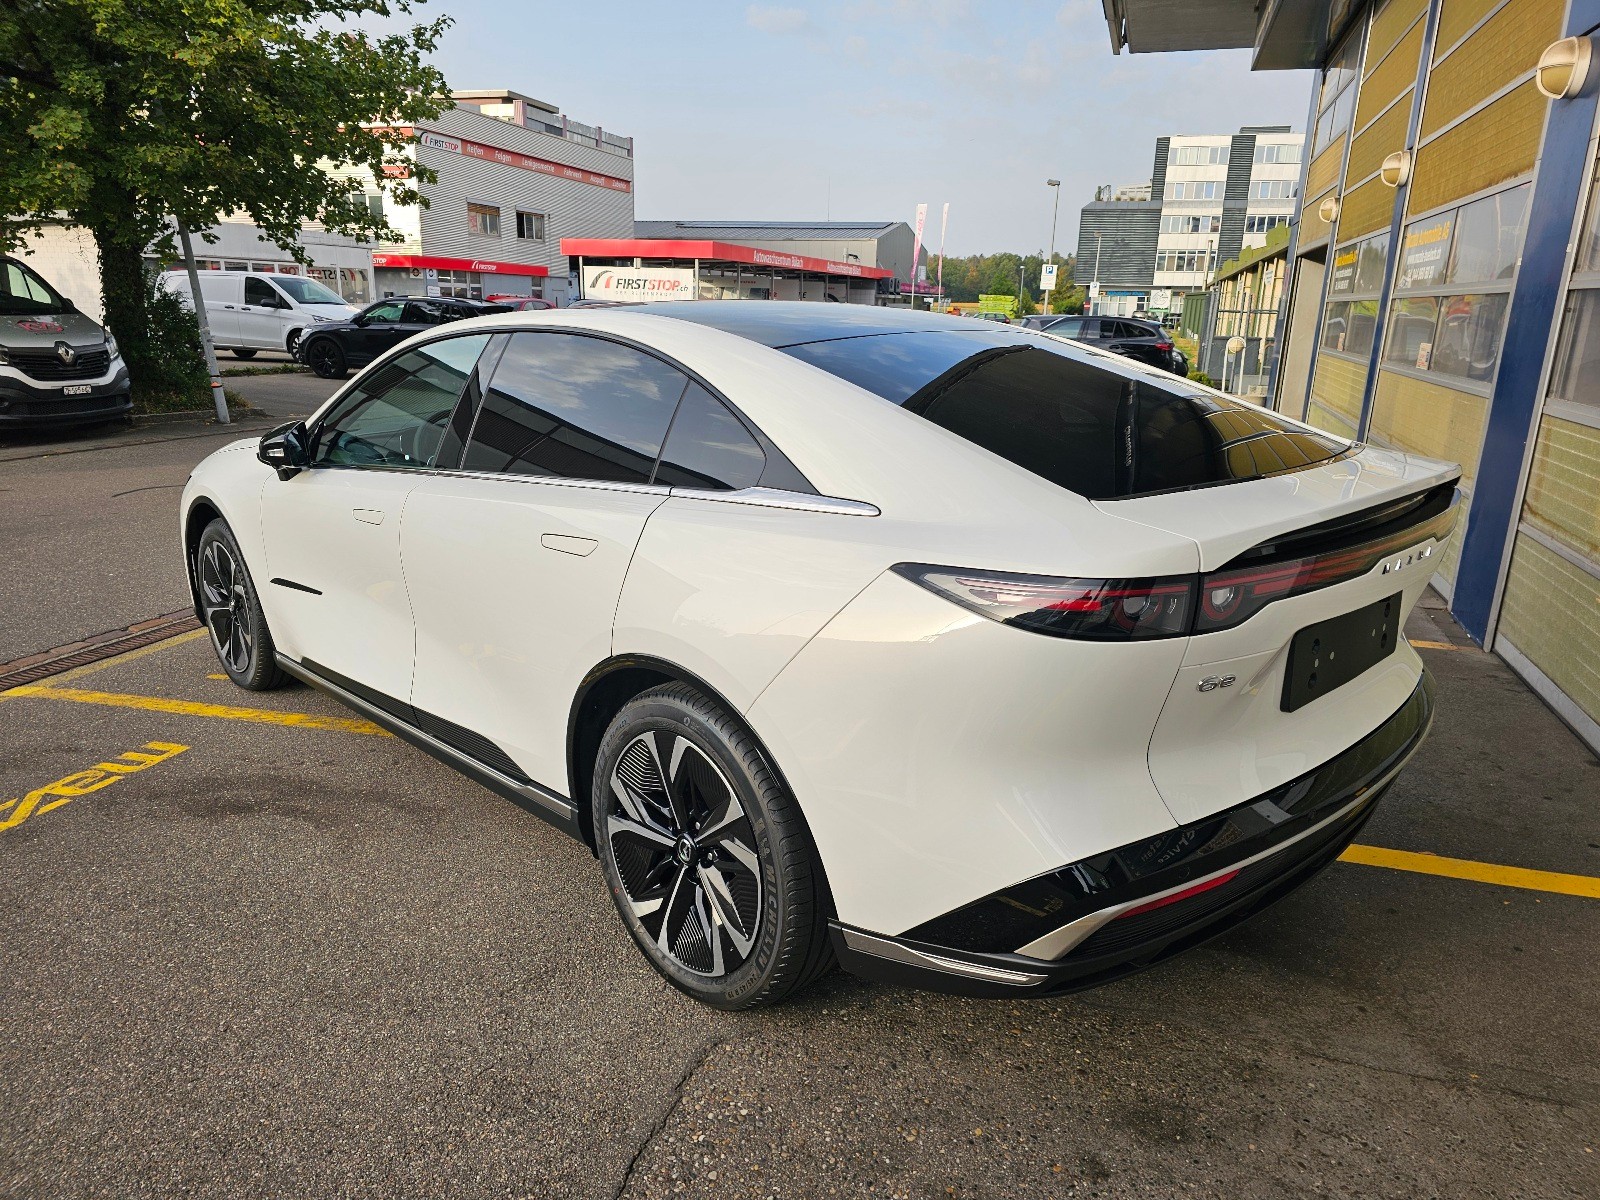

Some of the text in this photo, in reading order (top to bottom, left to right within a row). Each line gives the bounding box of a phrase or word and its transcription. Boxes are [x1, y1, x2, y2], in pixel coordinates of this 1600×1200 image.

[430, 138, 458, 151] FIRSTSTOP
[466, 143, 484, 156] Reifen
[495, 150, 512, 162] Felgen
[757, 863, 778, 970] MICHELIN
